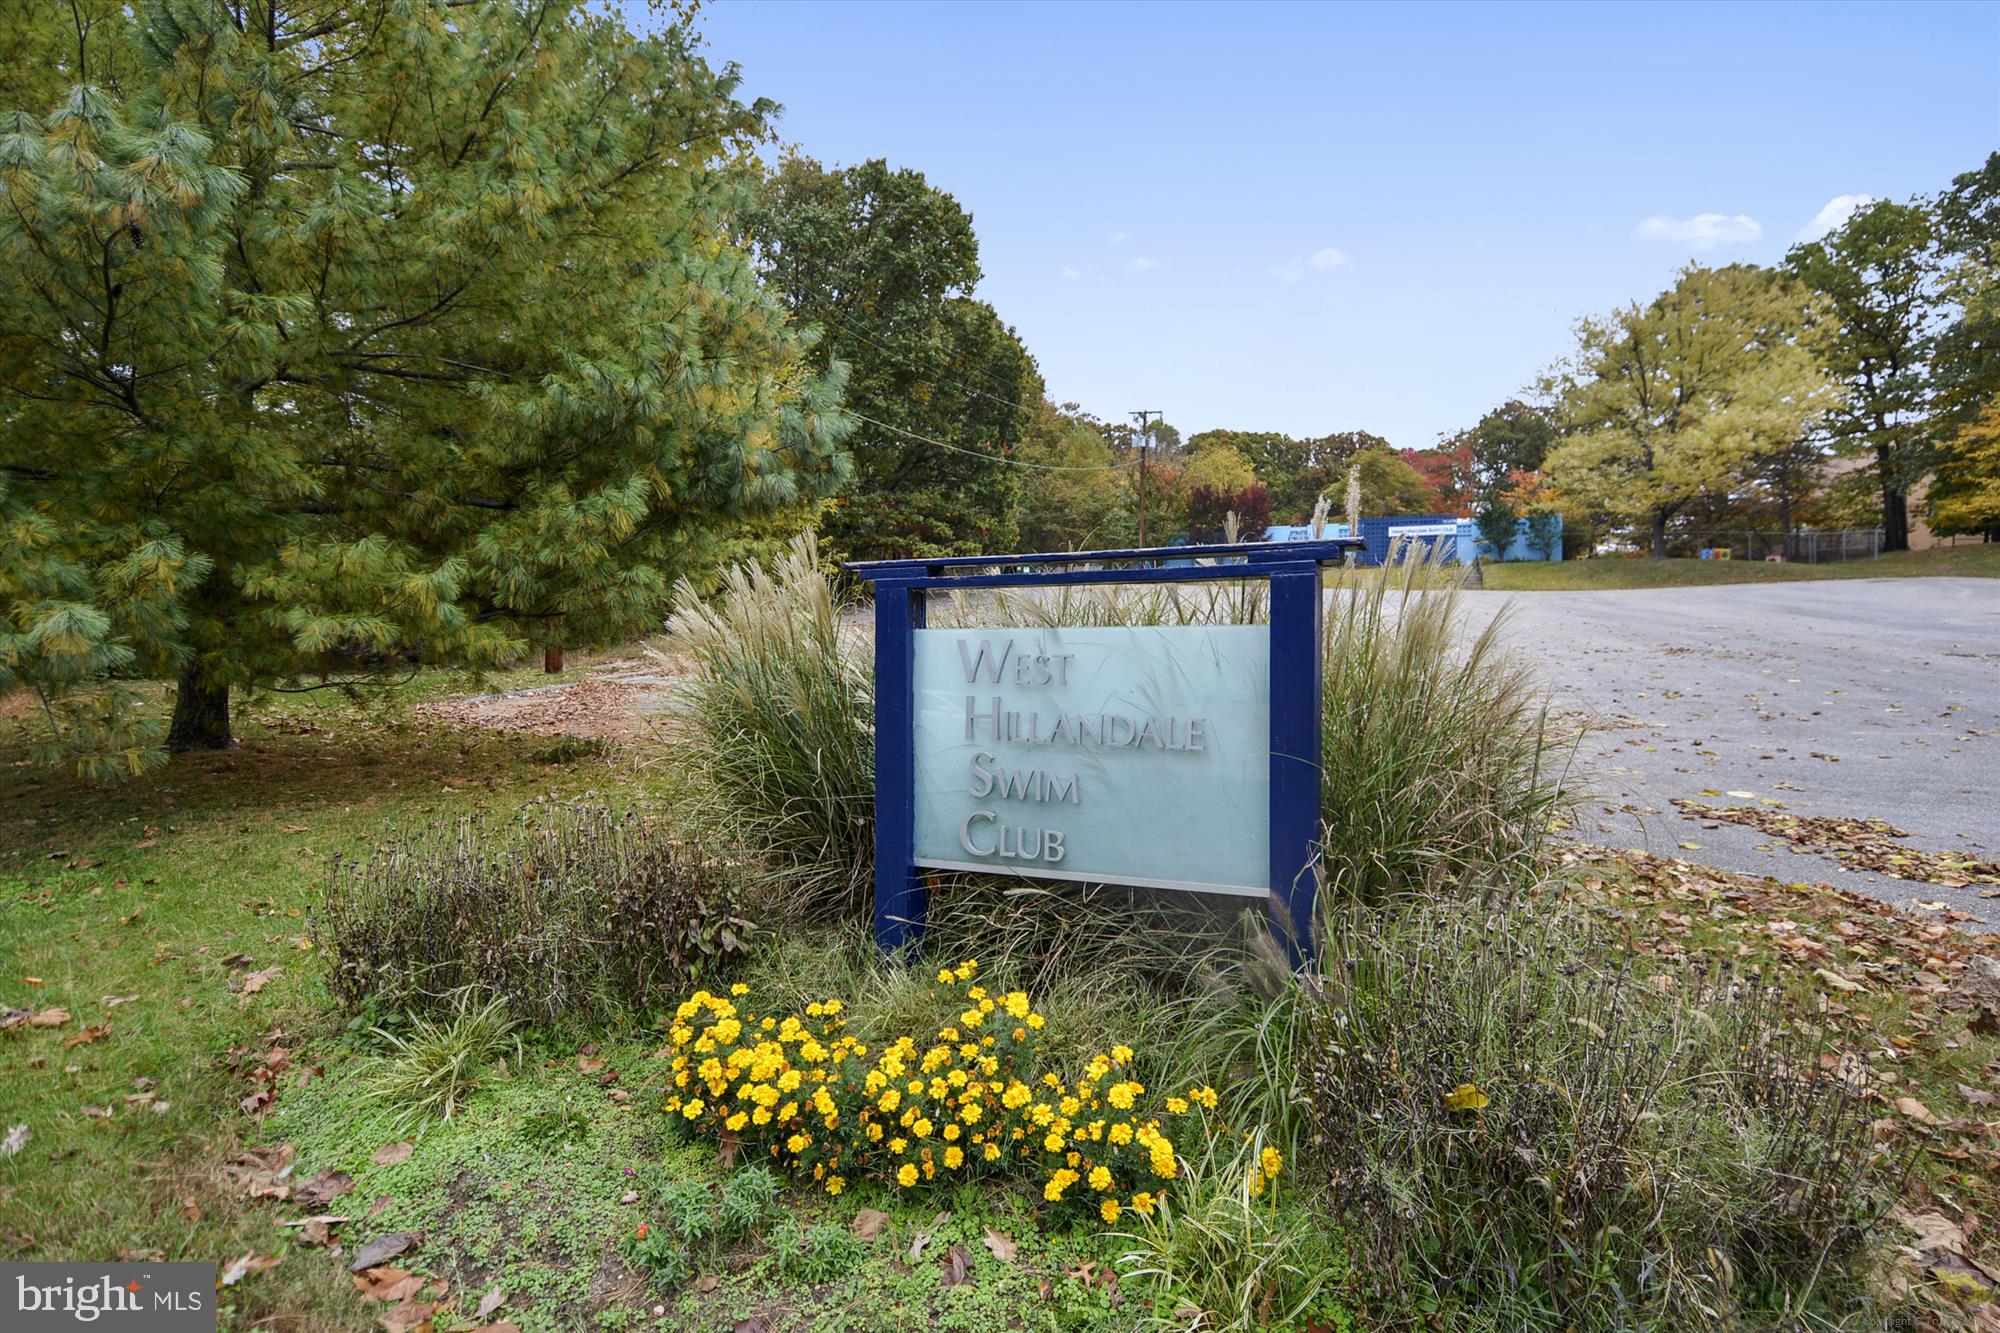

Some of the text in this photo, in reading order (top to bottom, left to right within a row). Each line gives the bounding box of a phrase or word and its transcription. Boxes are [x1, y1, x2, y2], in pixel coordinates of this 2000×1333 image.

[956, 639, 1075, 686] WEST
[964, 695, 1206, 751] HILLANDALE
[968, 752, 1081, 804] SWIM
[959, 809, 1066, 862] CLUB
